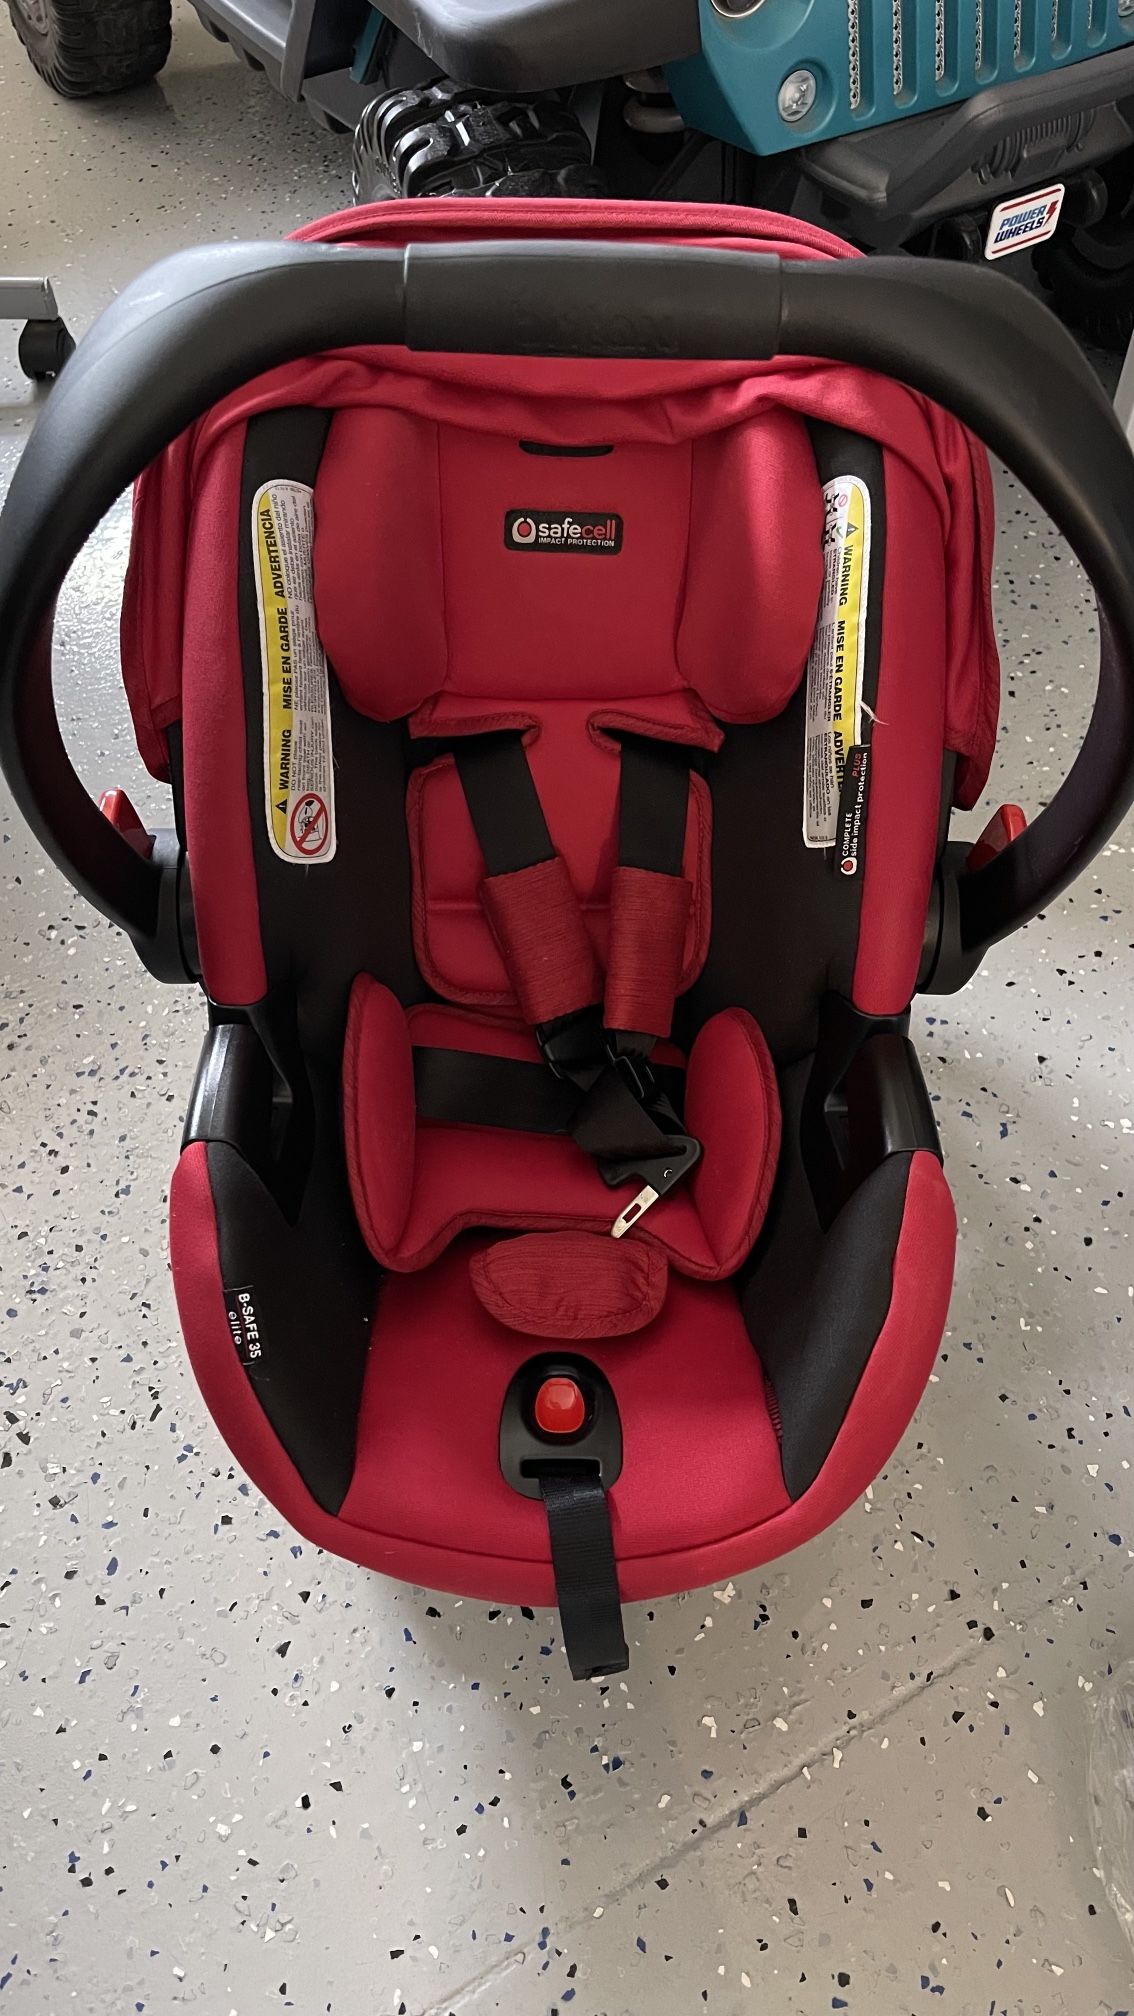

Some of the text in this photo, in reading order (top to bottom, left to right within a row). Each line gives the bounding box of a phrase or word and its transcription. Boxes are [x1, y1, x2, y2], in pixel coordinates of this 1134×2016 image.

[993, 216, 1045, 244] WHEELS
[999, 204, 1048, 230] POWER
[260, 508, 285, 599] ADVERTENCIA
[538, 517, 616, 539] safecell
[538, 537, 615, 547] IMPACT PROTECTION
[839, 544, 854, 606] WARNING
[277, 607, 292, 710] MISE EN GARDE
[833, 620, 846, 721] MISE EN GARDE
[279, 729, 292, 791] WARNING
[842, 753, 862, 857] COMPLETE PLUS
[850, 752, 868, 857] side impact protection
[228, 1311, 242, 1345] elite
[238, 1293, 262, 1358] B-SAFE 35
